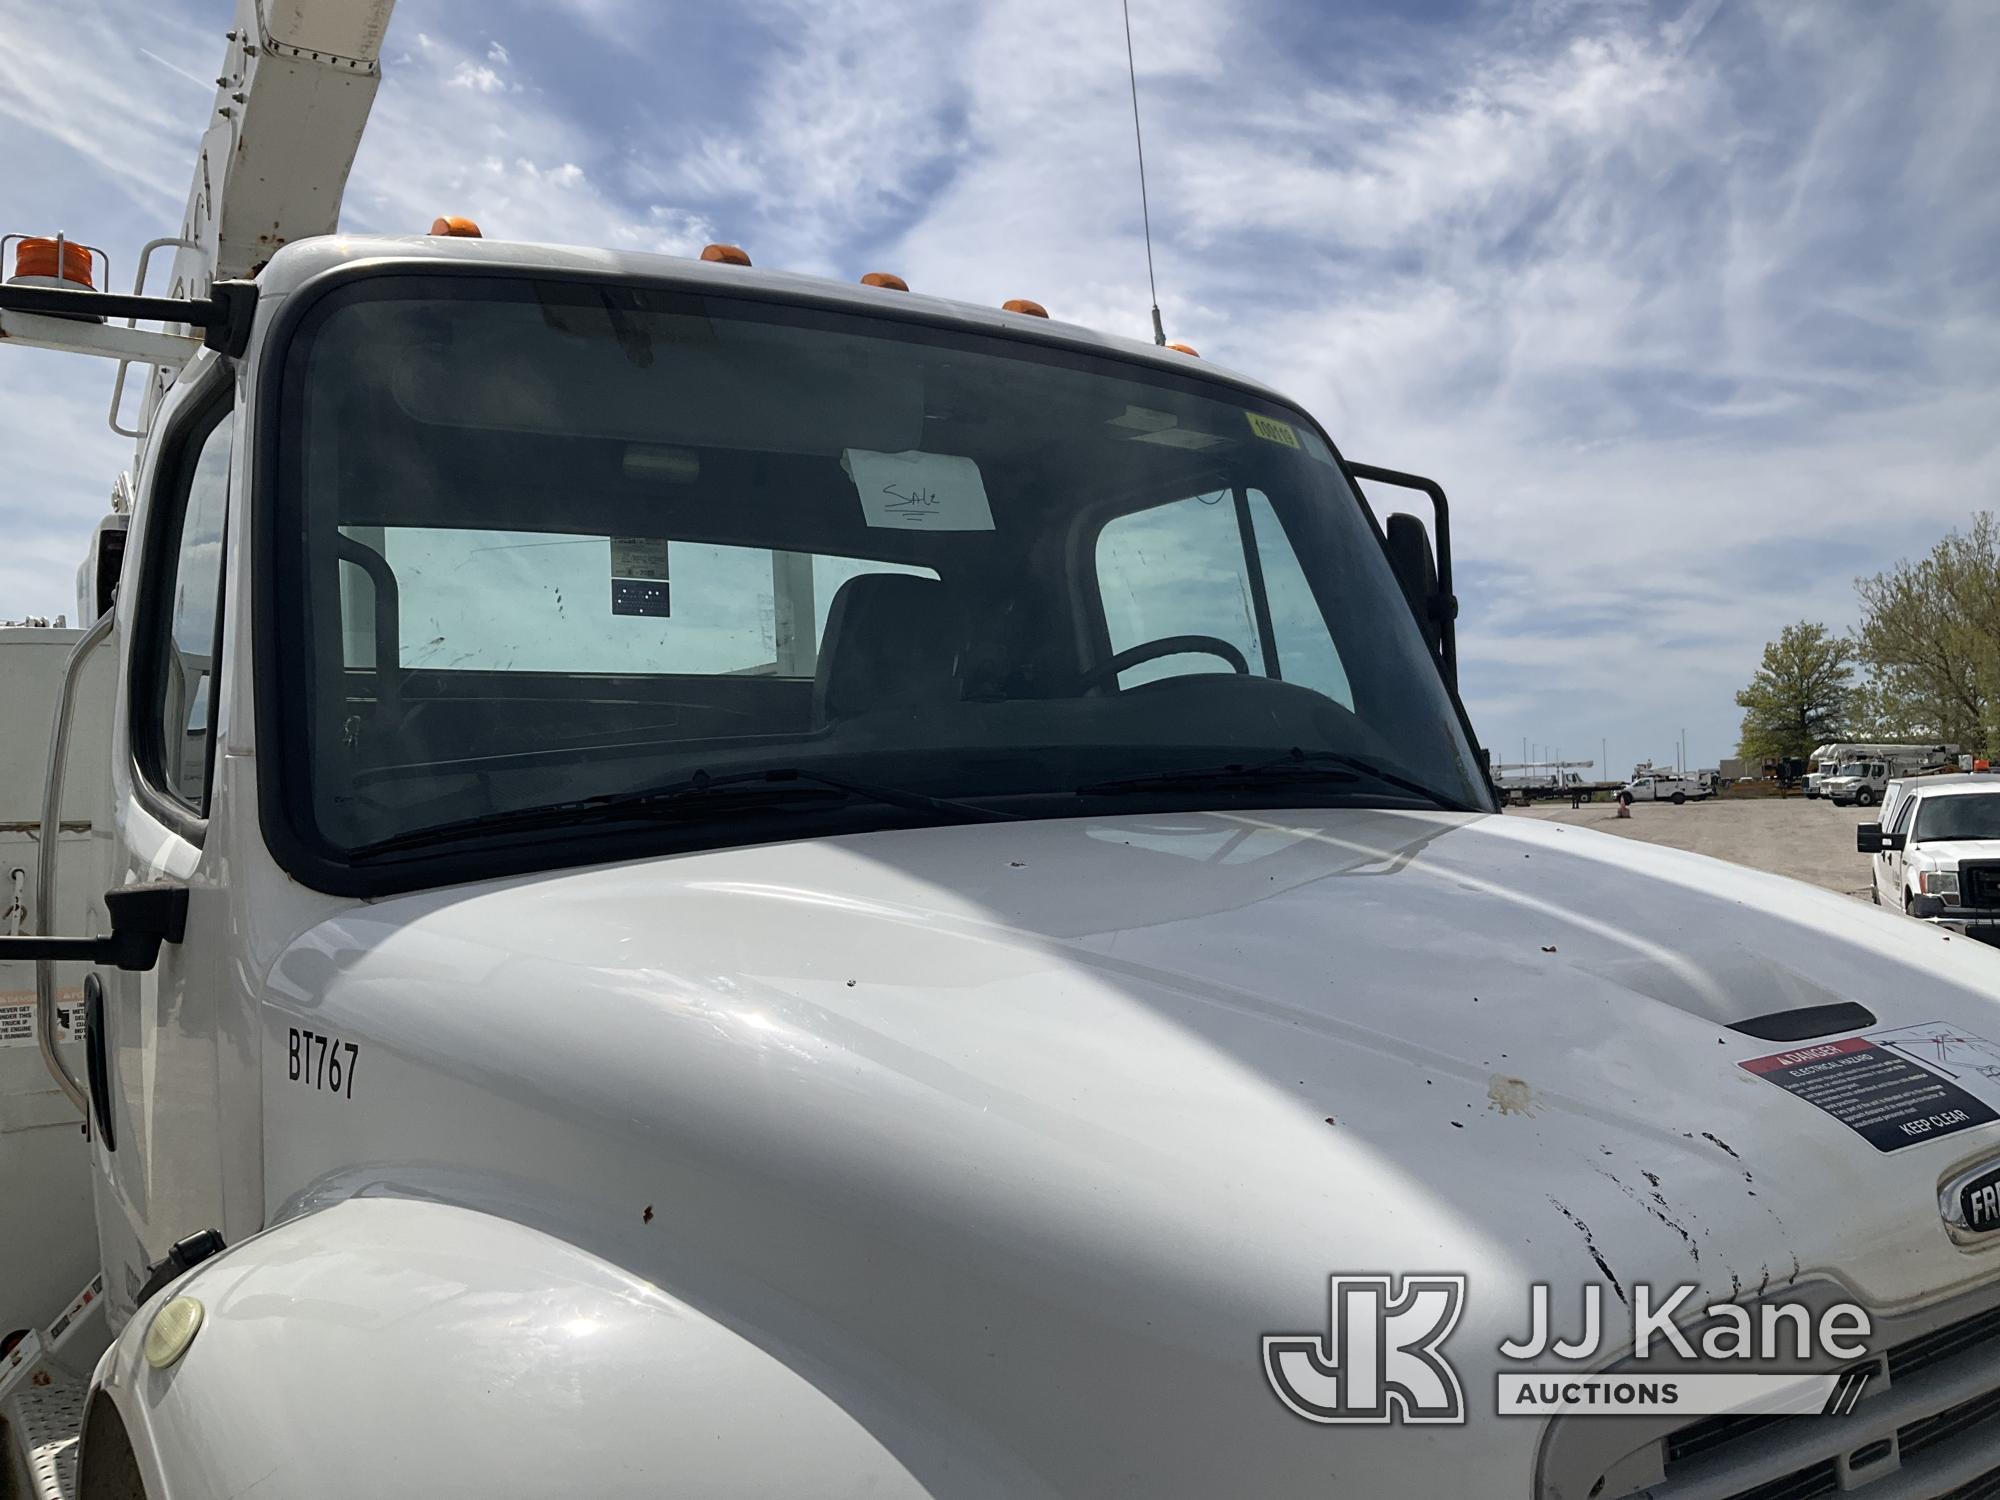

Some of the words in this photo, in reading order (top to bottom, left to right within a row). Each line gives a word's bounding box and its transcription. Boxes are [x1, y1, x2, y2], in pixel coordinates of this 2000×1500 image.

[288, 1027, 359, 1099] BT767
[1789, 1045, 1842, 1064] DANGER
[1789, 1060, 1841, 1077] ELECTRICAL
[1840, 1053, 1875, 1068] HAZARD
[1899, 1118, 1932, 1137] KEEP
[1930, 1109, 1970, 1129] CLEAR
